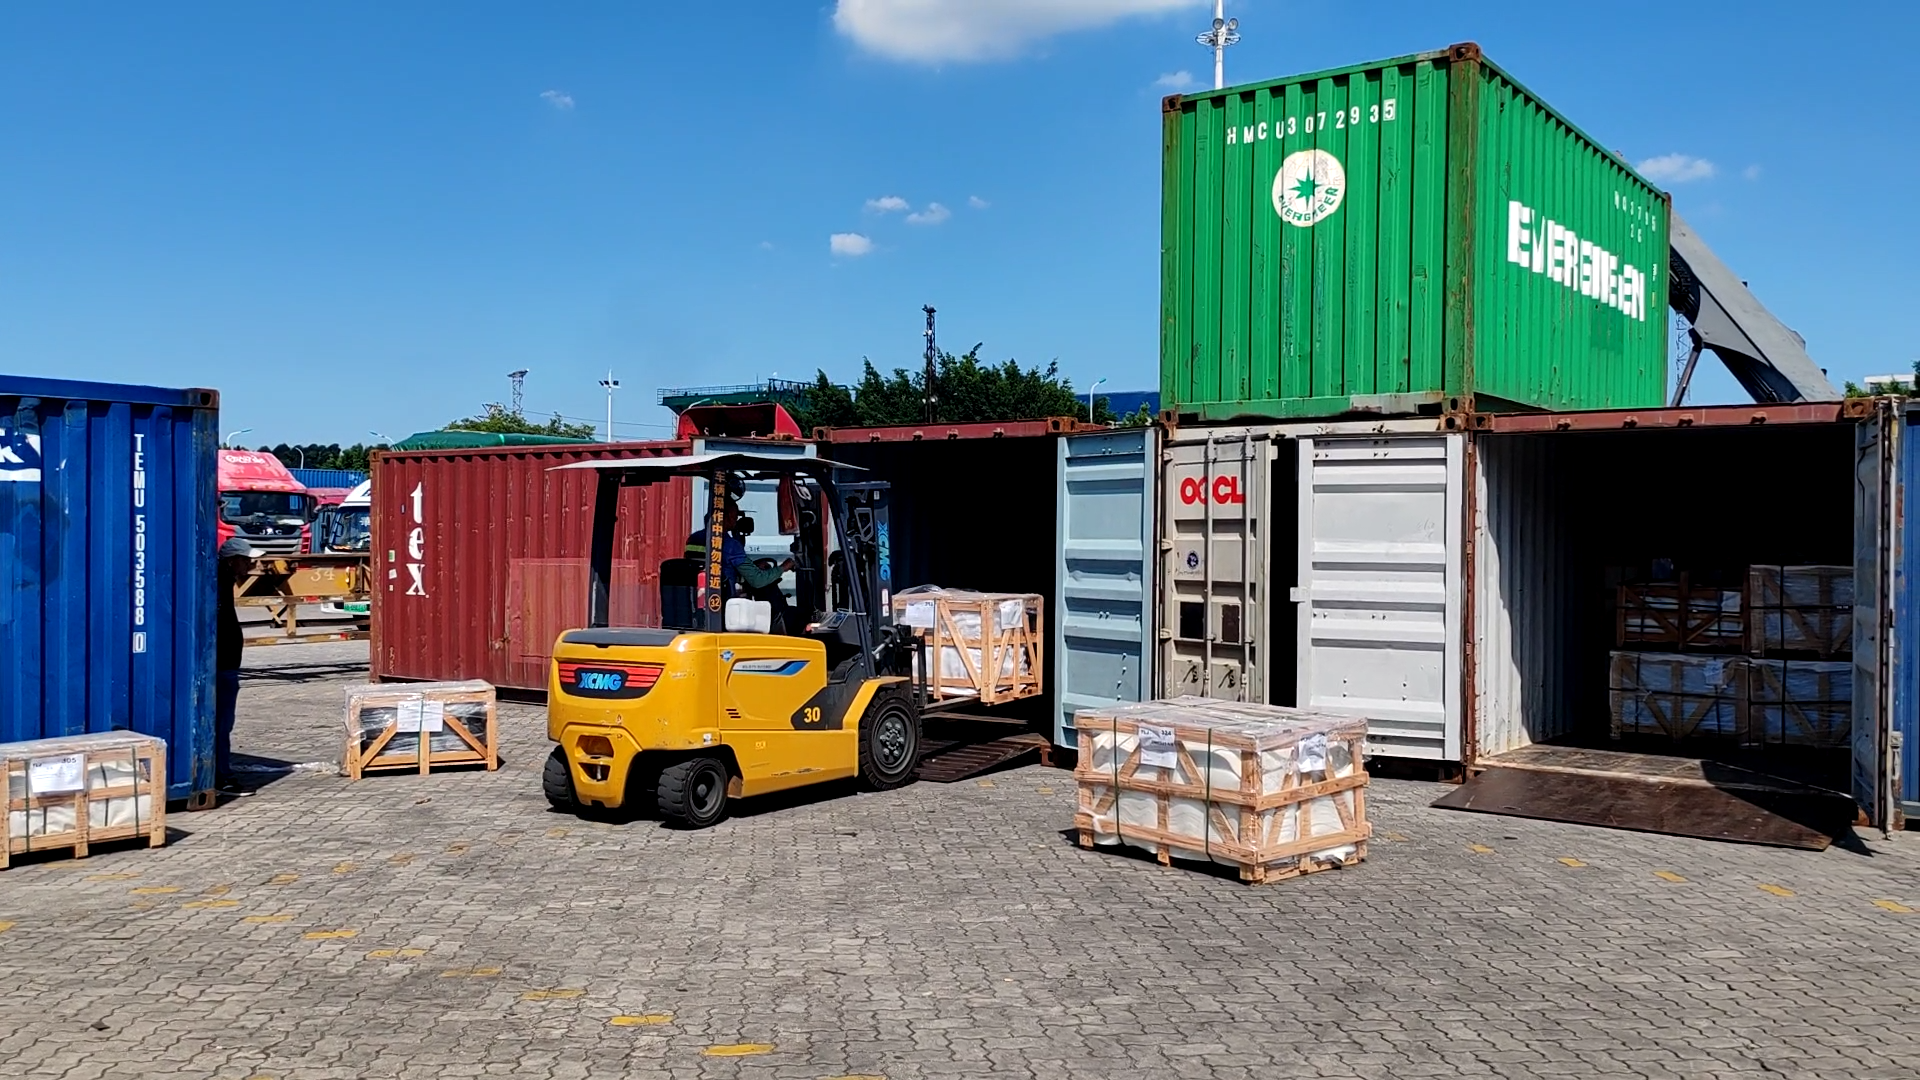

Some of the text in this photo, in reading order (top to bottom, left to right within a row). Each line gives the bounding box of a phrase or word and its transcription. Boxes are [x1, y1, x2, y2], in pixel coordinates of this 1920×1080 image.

[133, 433, 145, 508] TEMU
[1180, 475, 1247, 506] OOCL
[876, 519, 892, 581] XCMG
[134, 514, 146, 626] 503588
[310, 568, 336, 582] 34
[577, 672, 623, 691] XCMG
[803, 706, 821, 723] 30
